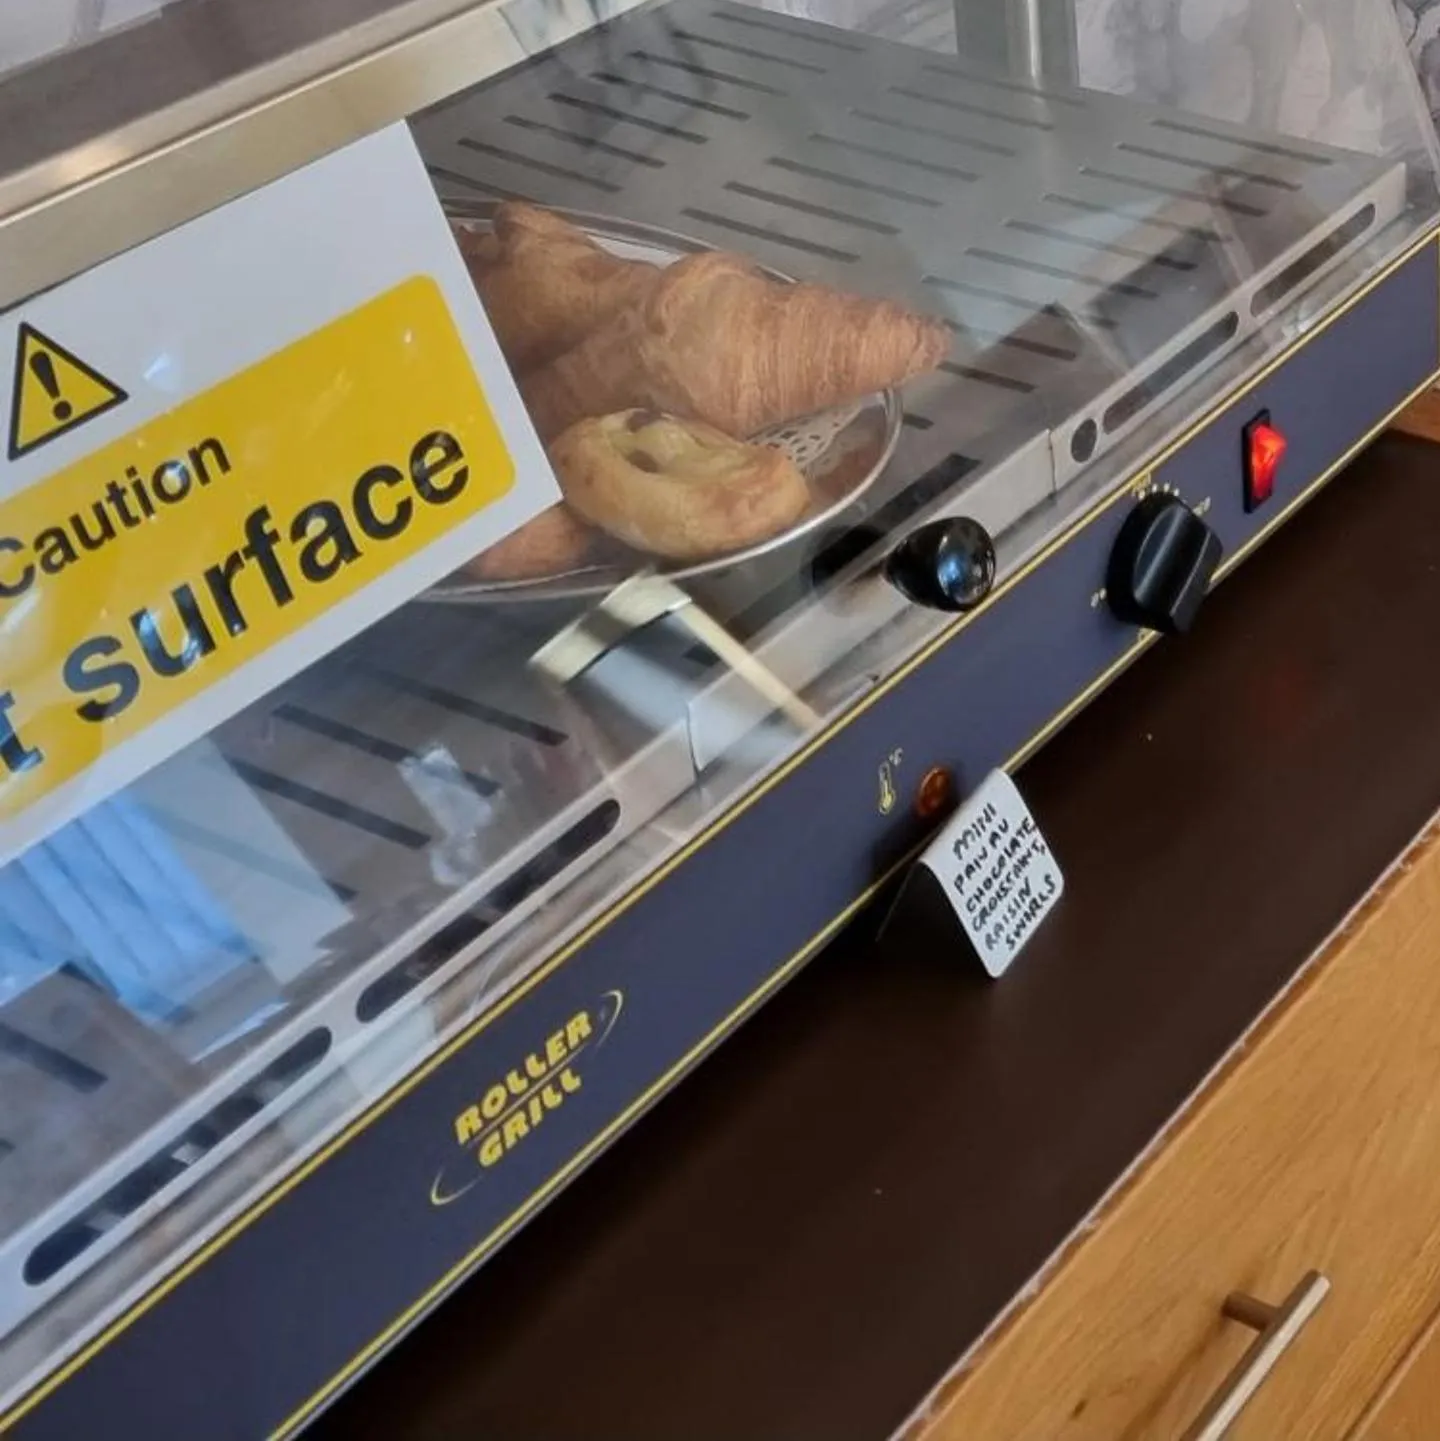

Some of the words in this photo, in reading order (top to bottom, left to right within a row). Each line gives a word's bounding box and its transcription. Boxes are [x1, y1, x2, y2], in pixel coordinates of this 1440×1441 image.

[61, 428, 469, 724] surface
[952, 801, 997, 861] MINI
[953, 845, 989, 896] PAIN
[989, 818, 1010, 851] AU
[965, 816, 1036, 914] CHOCOLATE
[984, 875, 1034, 951] RAISIN
[1005, 873, 1057, 951] SWIRLS
[455, 1011, 592, 1145] ROLLER
[479, 1068, 582, 1168] GRILL
